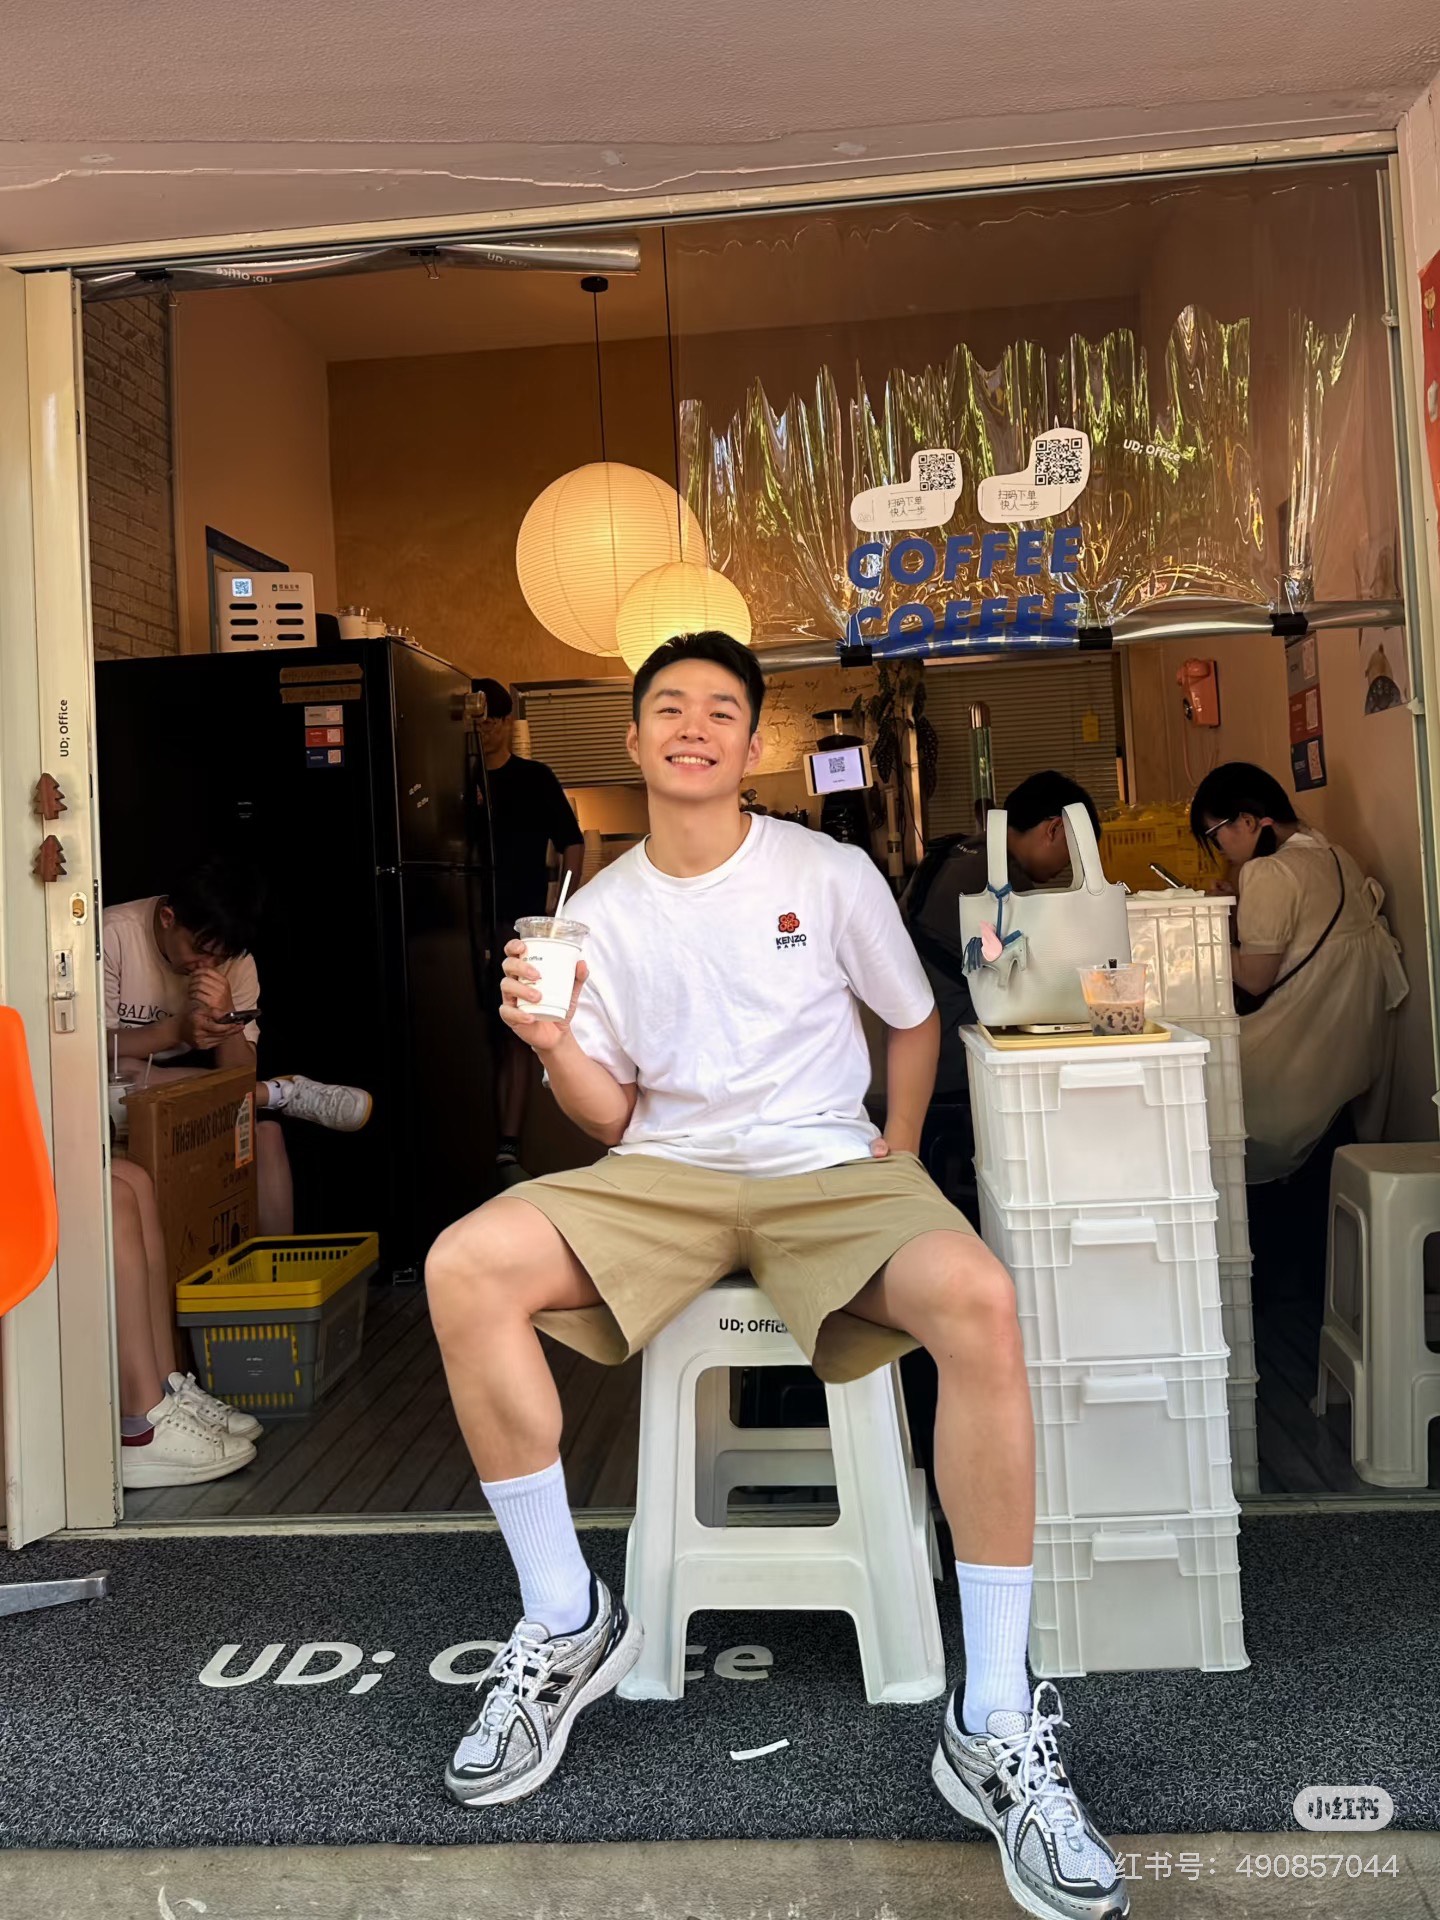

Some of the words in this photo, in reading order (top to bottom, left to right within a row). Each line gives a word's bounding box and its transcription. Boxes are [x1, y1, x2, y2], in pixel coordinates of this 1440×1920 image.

[1123, 439, 1144, 454] UD;
[1145, 444, 1180, 461] Office
[888, 496, 921, 508] 扫码下单
[998, 489, 1037, 500] 扫码下单
[890, 506, 925, 517] 快人一步
[1000, 499, 1039, 511] 快人一步
[849, 527, 1081, 589] COFFEE
[58, 699, 69, 735] Office
[59, 737, 71, 758] UD;
[776, 934, 807, 945] KENZO
[719, 1318, 744, 1333] UD;
[198, 1641, 396, 1694] UD;
